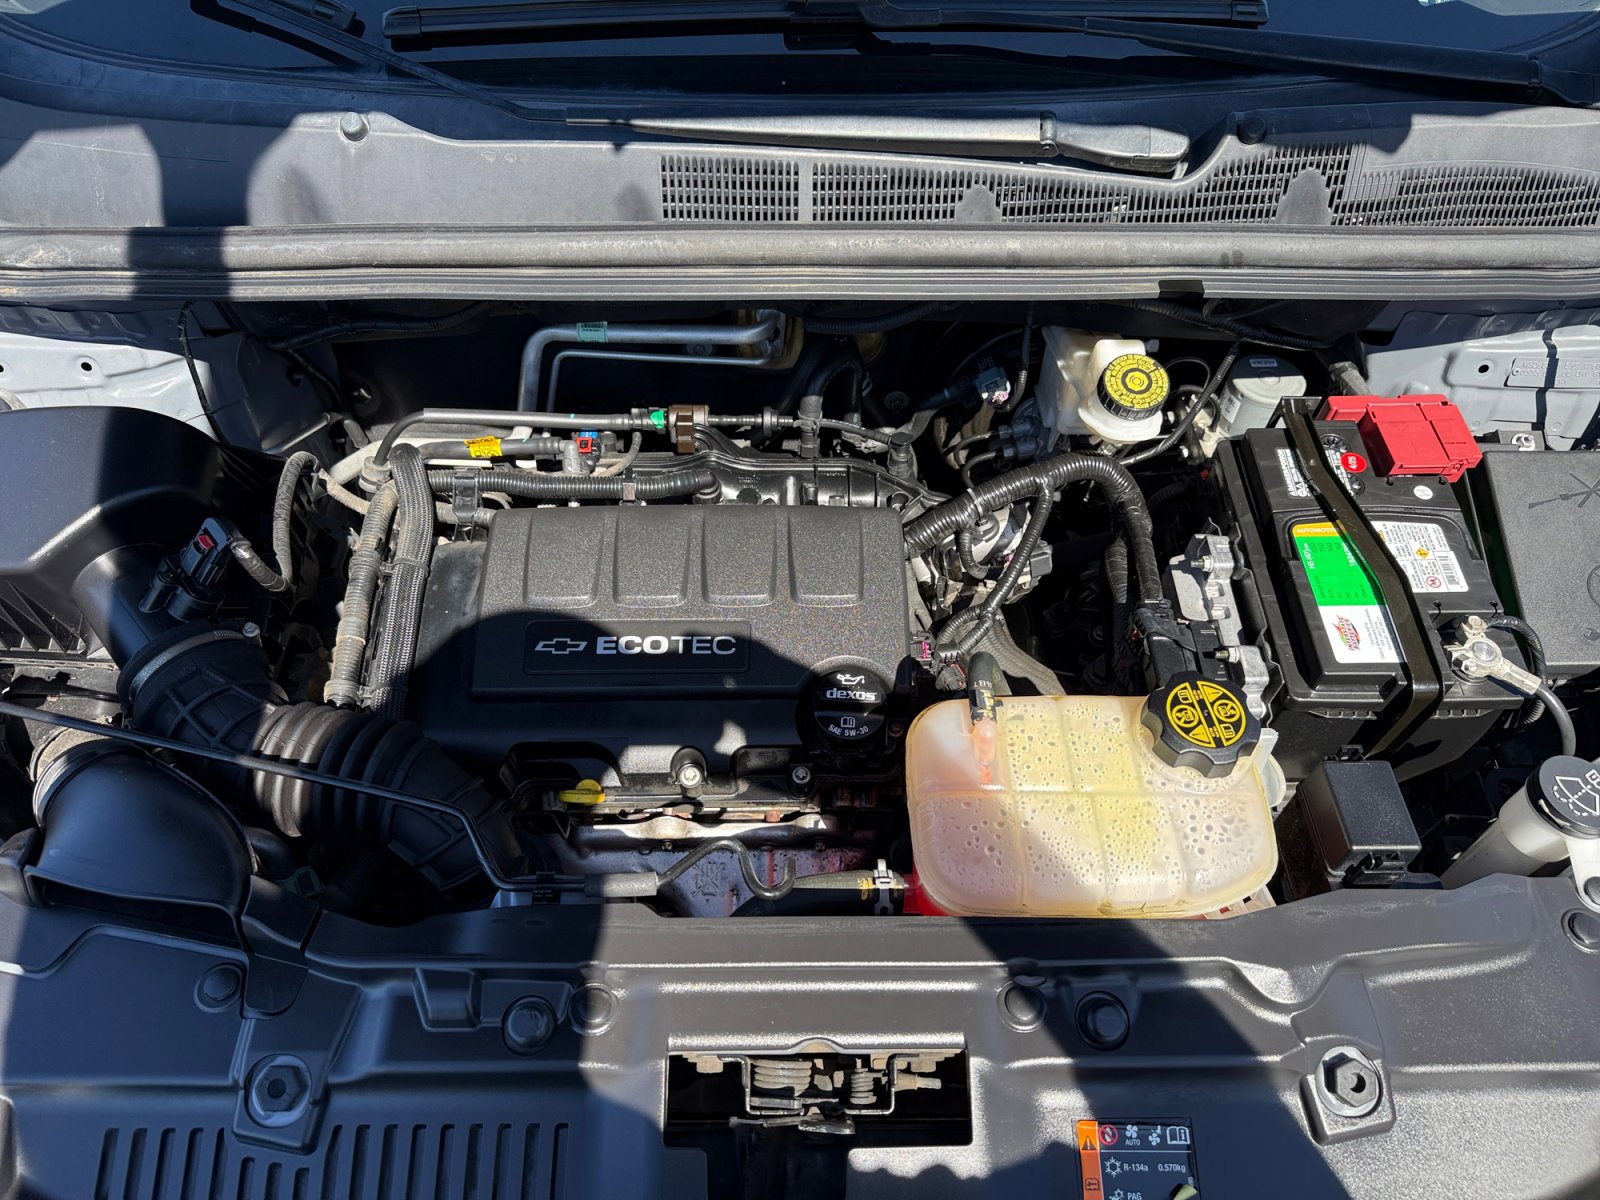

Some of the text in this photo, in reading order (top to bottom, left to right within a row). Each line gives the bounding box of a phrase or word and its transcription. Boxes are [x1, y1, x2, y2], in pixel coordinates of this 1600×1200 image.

[1336, 615, 1354, 651] INTERSTATE
[1345, 618, 1360, 651] BATTERIES
[596, 635, 736, 655] ECOTEC
[826, 688, 877, 701] dexos
[828, 724, 869, 737] SAE 5W-30
[1158, 1164, 1186, 1172] 0.570kg
[1128, 1192, 1142, 1200] PAG
